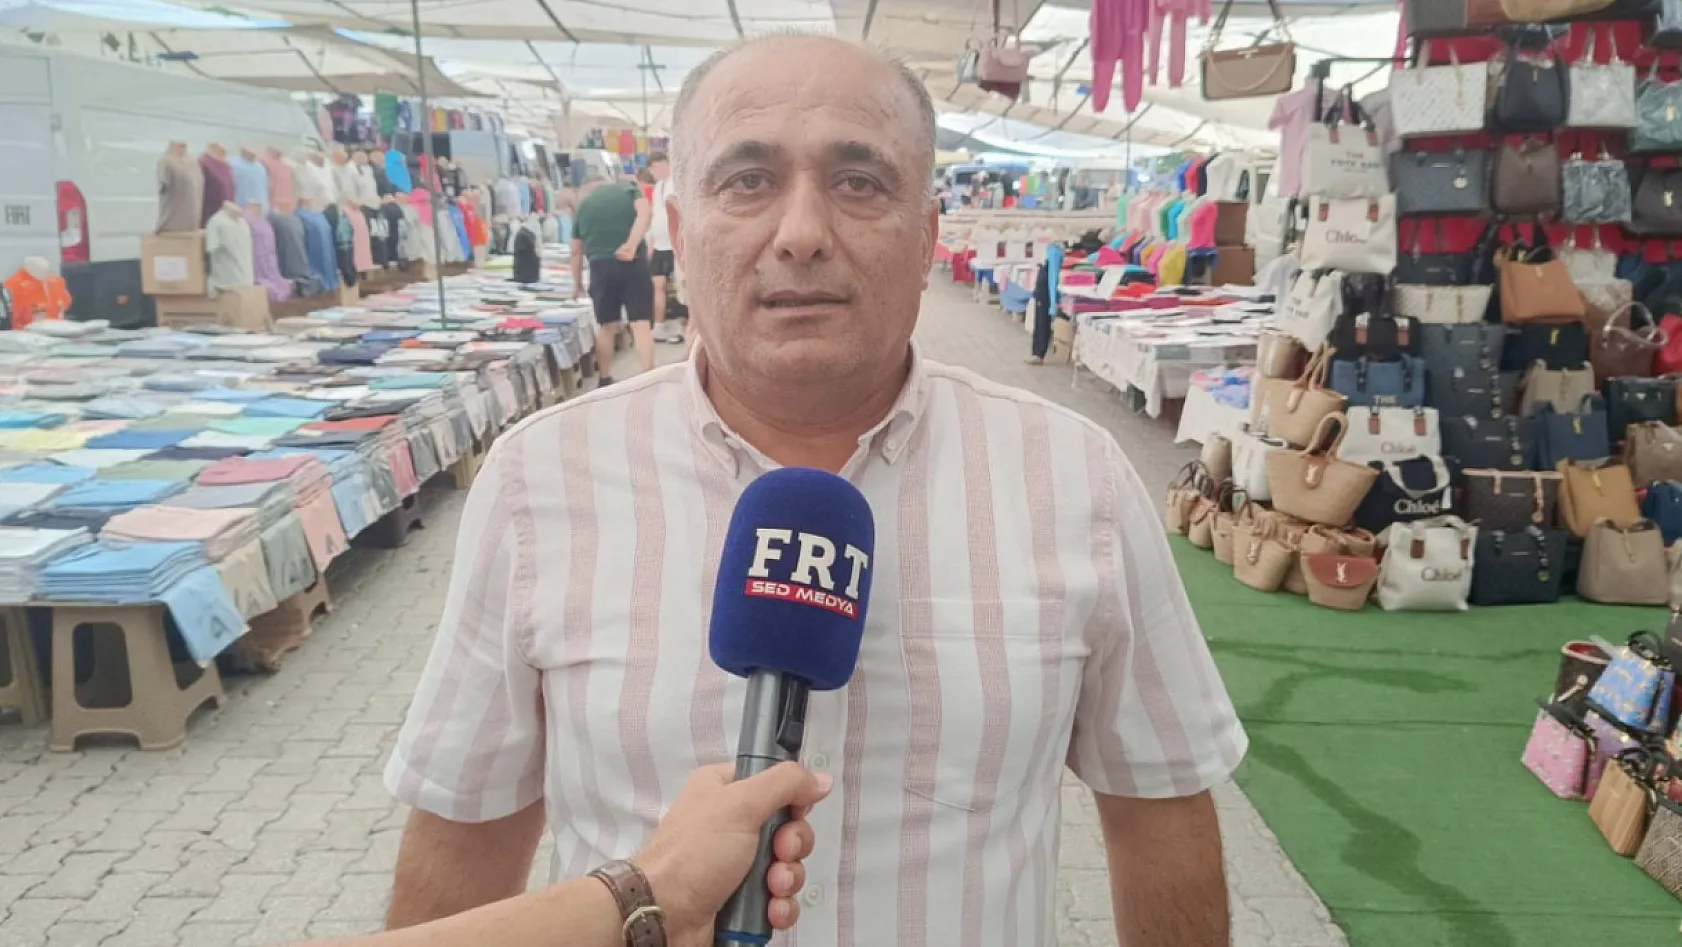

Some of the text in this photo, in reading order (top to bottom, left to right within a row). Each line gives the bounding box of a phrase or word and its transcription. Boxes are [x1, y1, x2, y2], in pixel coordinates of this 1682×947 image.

[5, 204, 31, 226] FIAT
[748, 528, 868, 600] FRT
[751, 581, 854, 615] SED MEDYA
